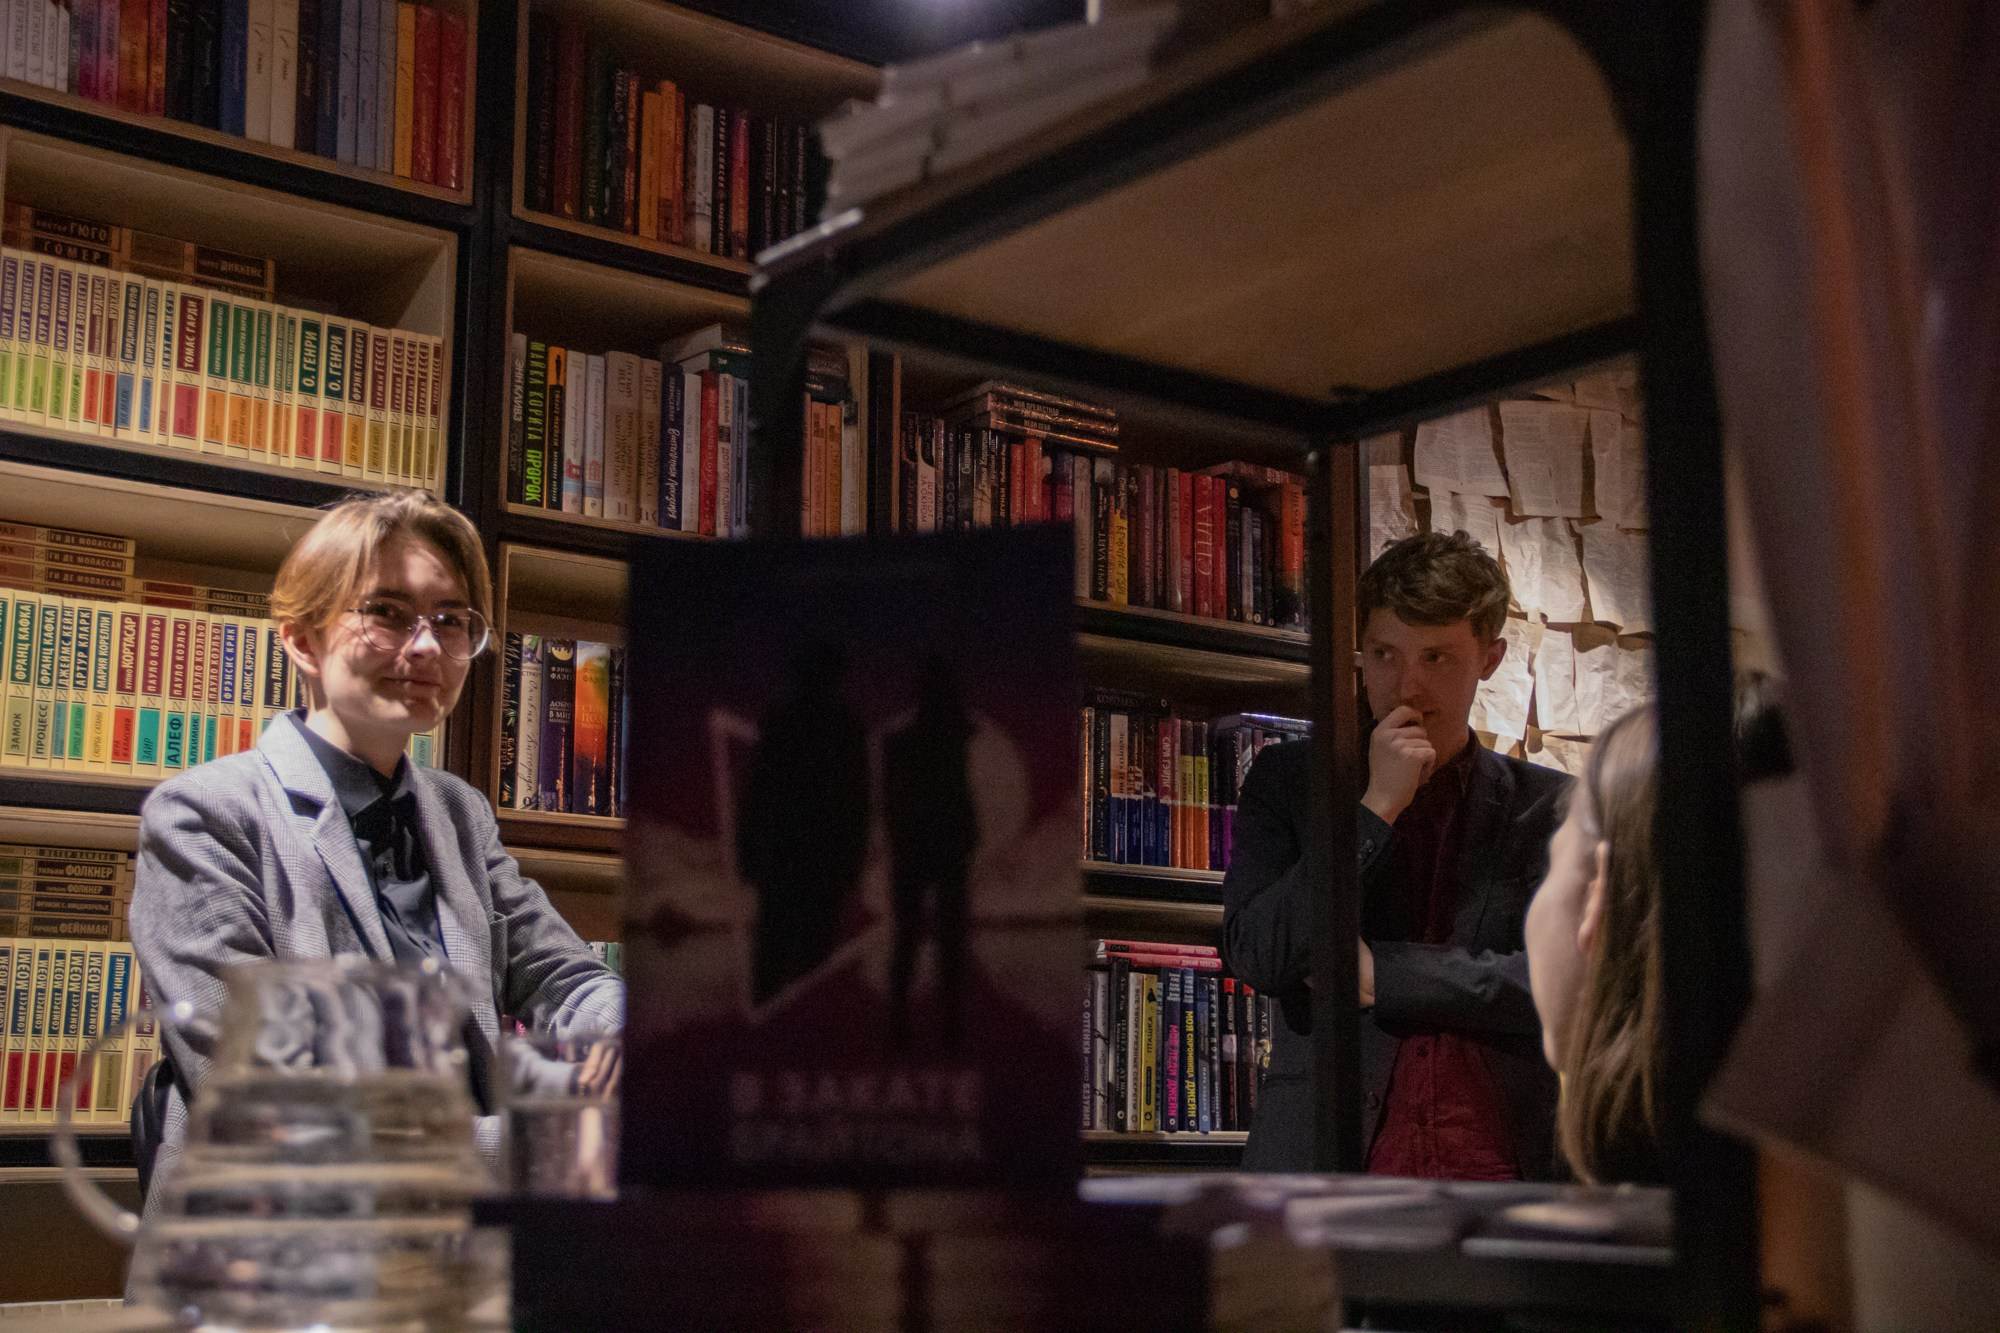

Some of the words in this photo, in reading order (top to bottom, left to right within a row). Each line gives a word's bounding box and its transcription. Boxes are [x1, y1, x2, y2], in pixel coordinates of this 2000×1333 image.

[70, 222, 108, 242] ГЮГО
[44, 242, 101, 262] ГОМЕР
[3, 261, 15, 310] ВОННЕГУТ
[20, 264, 33, 312] ВОННЕГУТ
[38, 268, 52, 315] ВОННЕГУТ
[58, 274, 70, 322] ВОННЕГУТ
[76, 277, 88, 325] ВОННЕГУТ
[93, 280, 104, 315] ВУДХАУС
[109, 282, 119, 319] ВУДХАУС
[128, 286, 138, 308] ВУЛФ
[148, 292, 157, 313] ВУЛФ
[164, 294, 174, 335] ГАМСУН
[186, 300, 197, 333] ГАРДИ
[0, 313, 12, 335] КУРТ
[19, 316, 29, 339] КУРТ
[37, 318, 48, 341] КУРТ
[56, 325, 67, 348] КУРТ
[75, 329, 85, 351] КУРТ
[125, 310, 136, 359] ВИРДЖИНИЯ
[145, 315, 156, 364] ВИРДЖИНИЯ
[162, 347, 172, 366] КНУТ
[184, 336, 196, 368] ТОМАС
[303, 331, 317, 371] ГЕНРИ
[329, 336, 343, 375] ГЕНРИ
[354, 332, 364, 369] ГЕРБЕРТ
[375, 341, 386, 372] ГЕССЕ
[393, 344, 403, 375] ГЕССЕ
[407, 346, 416, 377] ГЕССЕ
[417, 348, 428, 379] ГЕССЕ
[303, 376, 315, 387] О.
[328, 379, 340, 391] О.
[352, 371, 362, 400] ФРЭНК
[514, 360, 524, 381] ЭНН
[120, 389, 130, 412] МАЯК
[376, 375, 384, 406] ГЕРМАН
[407, 380, 415, 411] ГЕРМАН
[418, 381, 426, 412] ГЕРМАН
[513, 386, 523, 422] КЛИВЗ
[121, 414, 128, 424] НА
[528, 391, 544, 440] КОРИТА
[525, 449, 542, 502] ПРОРОК
[722, 447, 730, 484] ДОЛГОЕ
[921, 474, 926, 486] ЗА
[50, 534, 61, 543] ГИ
[64, 535, 76, 544] ДЕ
[79, 537, 124, 551] МОПАССАН
[49, 552, 59, 561] ГИ
[63, 554, 75, 563] ДЕ
[77, 556, 122, 569] МОПАССАН
[49, 571, 59, 581] ГИ
[63, 573, 75, 582] ДЕ
[77, 575, 122, 589] МОПАССАН
[16, 605, 32, 640] КАФКА
[42, 610, 55, 645] КАФКА
[61, 610, 73, 638] КЕЙН
[78, 611, 91, 647] КЛАРК
[99, 617, 110, 656] КОРЕЛЛИ
[149, 619, 161, 658] КОЭЛЬО
[122, 617, 136, 668] КОРТАСАР
[175, 623, 187, 661] КОЭЛЬО
[195, 625, 205, 663] КОЭЛЬО
[209, 628, 220, 665] КОЭЛЬО
[223, 629, 235, 653] КРИК
[245, 633, 255, 670] КЭРРОЛЛ
[270, 633, 283, 681] ЛАВКРАФТ
[14, 643, 30, 680] ФРАНЦ
[40, 648, 54, 685] ФРАНЦ
[57, 641, 71, 686] ДЖЕЙМС
[76, 651, 87, 686] АРТУР
[96, 658, 108, 688] МАРИЯ
[147, 660, 157, 692] ПАУЛО
[125, 668, 133, 690] ХУЛИО
[173, 664, 184, 695] ПАУЛО
[194, 665, 203, 697] ПАУЛО
[209, 668, 218, 699] ПАУЛО
[221, 657, 233, 699] ФРЭНСИС
[242, 672, 253, 702] ЛЬЮИС
[272, 682, 282, 705] ГОВАРД
[11, 713, 22, 749] ЗАМОК
[36, 704, 48, 754] ПРОЦЕСС
[167, 718, 181, 763] АЛЕФ
[190, 718, 200, 763] АЛХИМИК
[141, 738, 153, 760] ЗАИР
[65, 864, 113, 878] ФОЛКНЕР
[67, 884, 103, 894] ФОЛКНЕР
[59, 922, 108, 935] ФЕЙНМАН
[15, 953, 32, 990] МОЭМ
[35, 960, 48, 989] МОЭМ
[52, 959, 65, 989] МОЭМ
[68, 956, 84, 992] МОЭМ
[87, 956, 103, 993] МОЭМ
[113, 957, 126, 989] НИЦШЕ
[16, 991, 27, 1032] СОМЕРСЕТ
[34, 991, 46, 1029] СОМЕРСЕТ
[51, 991, 62, 1030] СОМЕРСЕТ
[68, 993, 80, 1034] СОМЕРСЕТ
[88, 994, 99, 1034] СОМЕРСЕТ
[1186, 1011, 1194, 1031] МОЯ
[1169, 1025, 1178, 1046] МОЯ
[1168, 1049, 1178, 1076] ЛЕДИ
[1167, 1078, 1179, 1116] ДЖЕЙН
[1185, 1080, 1196, 1117] ДЖЕЙН
